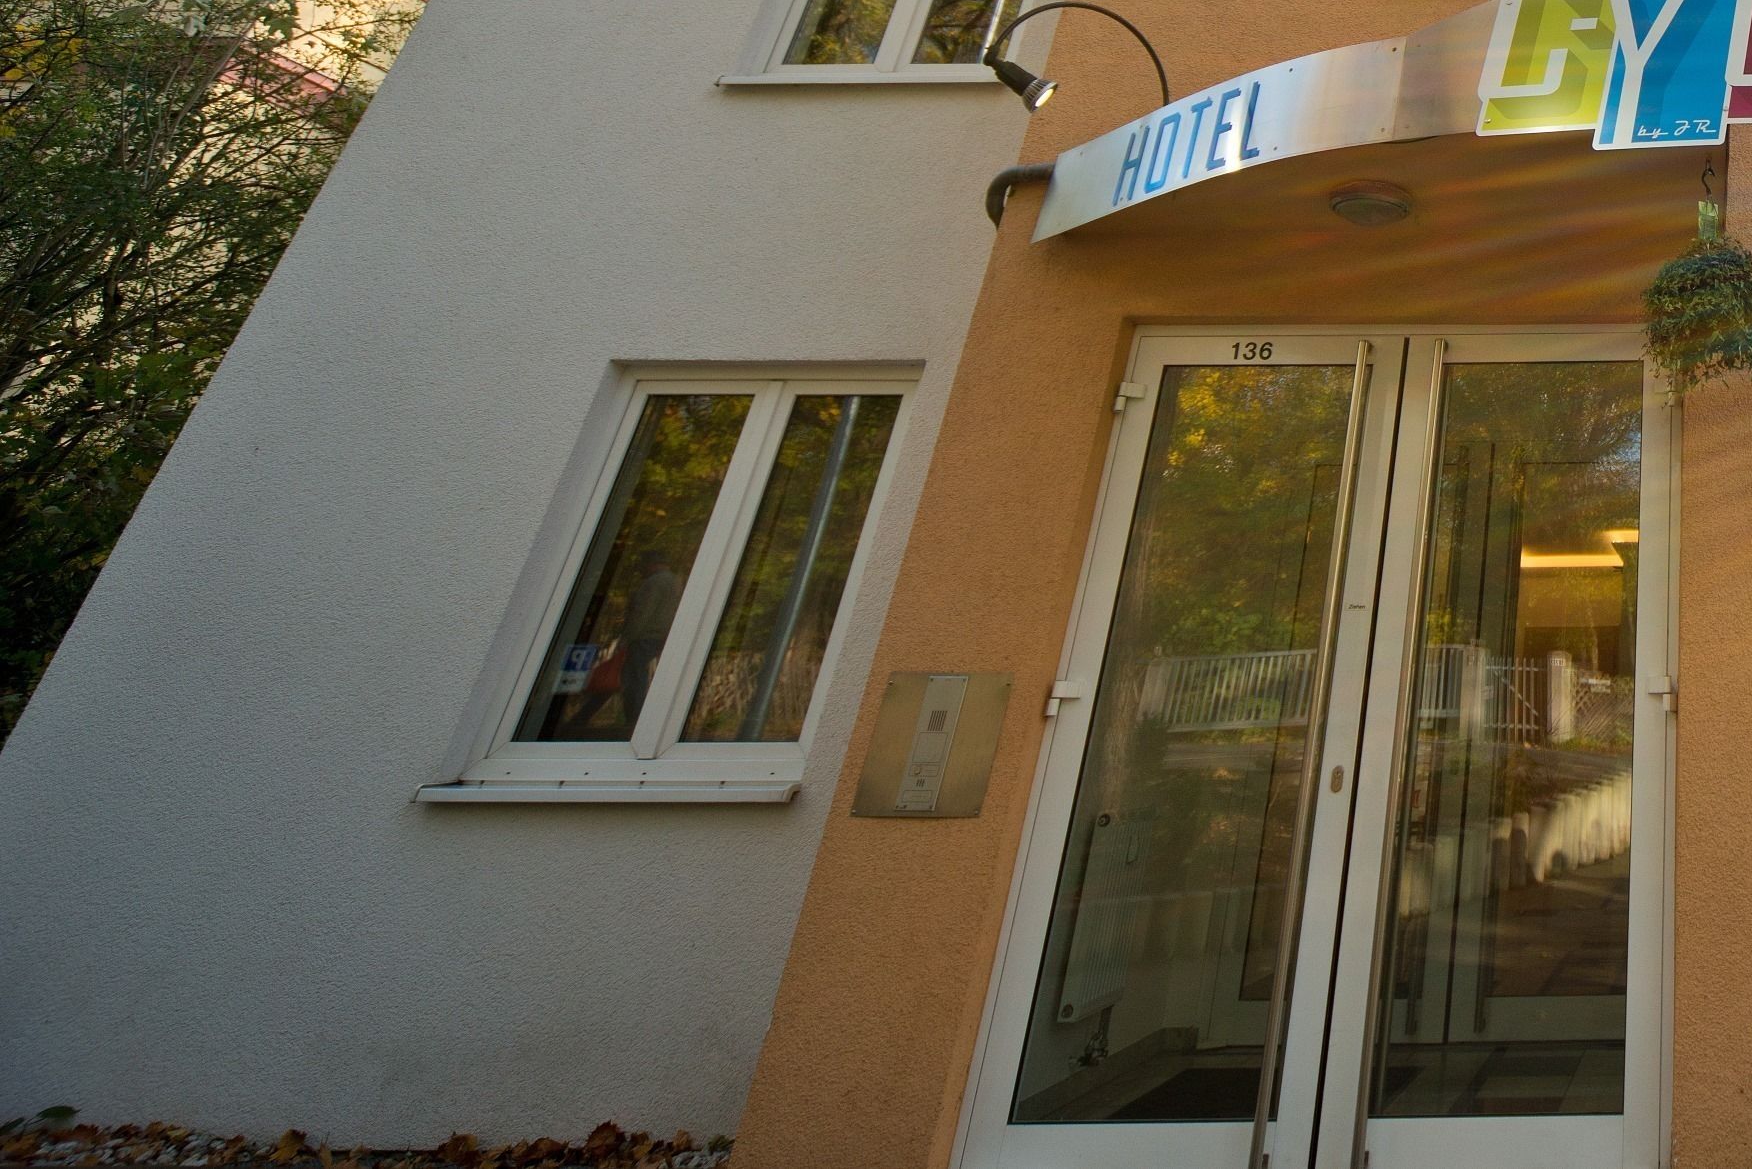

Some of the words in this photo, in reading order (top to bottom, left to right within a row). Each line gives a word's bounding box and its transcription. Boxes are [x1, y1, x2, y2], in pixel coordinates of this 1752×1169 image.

[1637, 125, 1669, 139] by
[1112, 80, 1261, 207] HOTEL
[1231, 341, 1273, 361] 136
